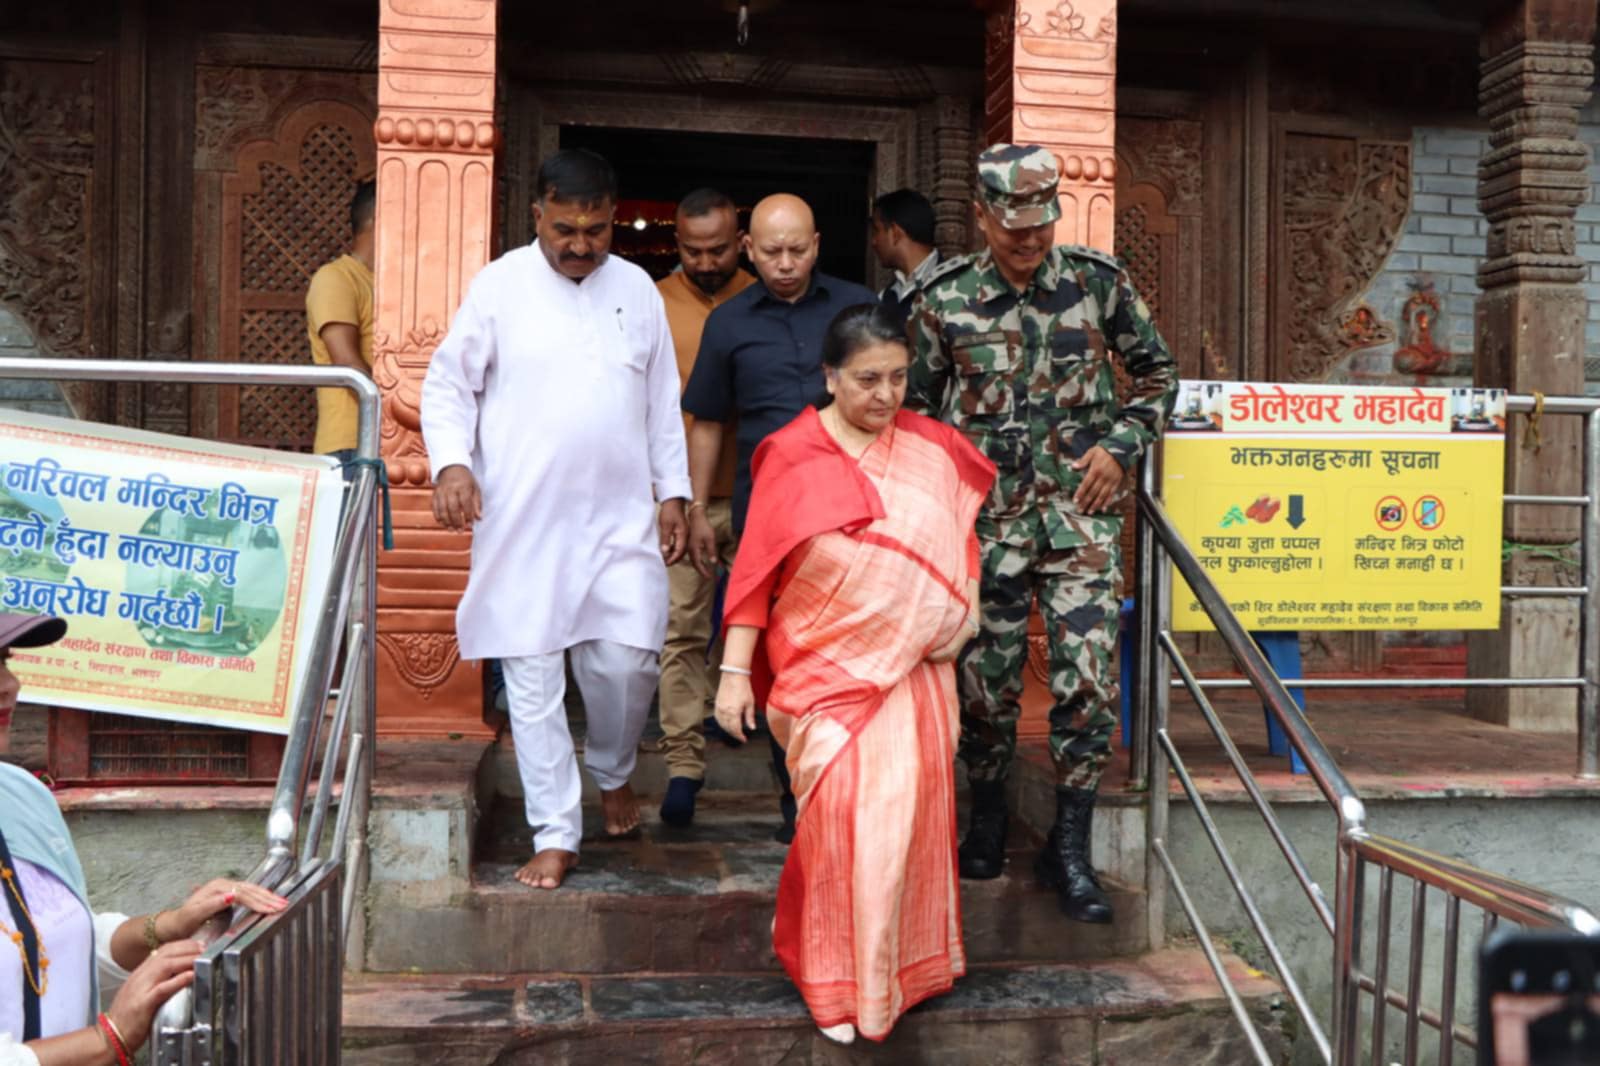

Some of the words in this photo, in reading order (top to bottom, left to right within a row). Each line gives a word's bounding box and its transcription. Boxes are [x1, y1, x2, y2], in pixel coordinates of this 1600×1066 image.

[1229, 385, 1344, 424] डोलेश्वर
[1353, 387, 1446, 424] महादेव
[1381, 450, 1440, 475] सूचना
[7, 457, 111, 502] नरिवल
[117, 473, 212, 518] मन्दिर
[218, 481, 280, 526] भित्र
[55, 517, 110, 564] हुँदा
[118, 534, 240, 586] नल्याउनु
[1201, 536, 1242, 553] कृपया
[1281, 536, 1321, 551] चप्पल
[1354, 535, 1396, 551] मन्दिर
[1401, 535, 1428, 552] भित्र
[1432, 535, 1464, 551] फोटो
[1395, 554, 1435, 572] मनाही
[2, 576, 111, 619] अनुरोध
